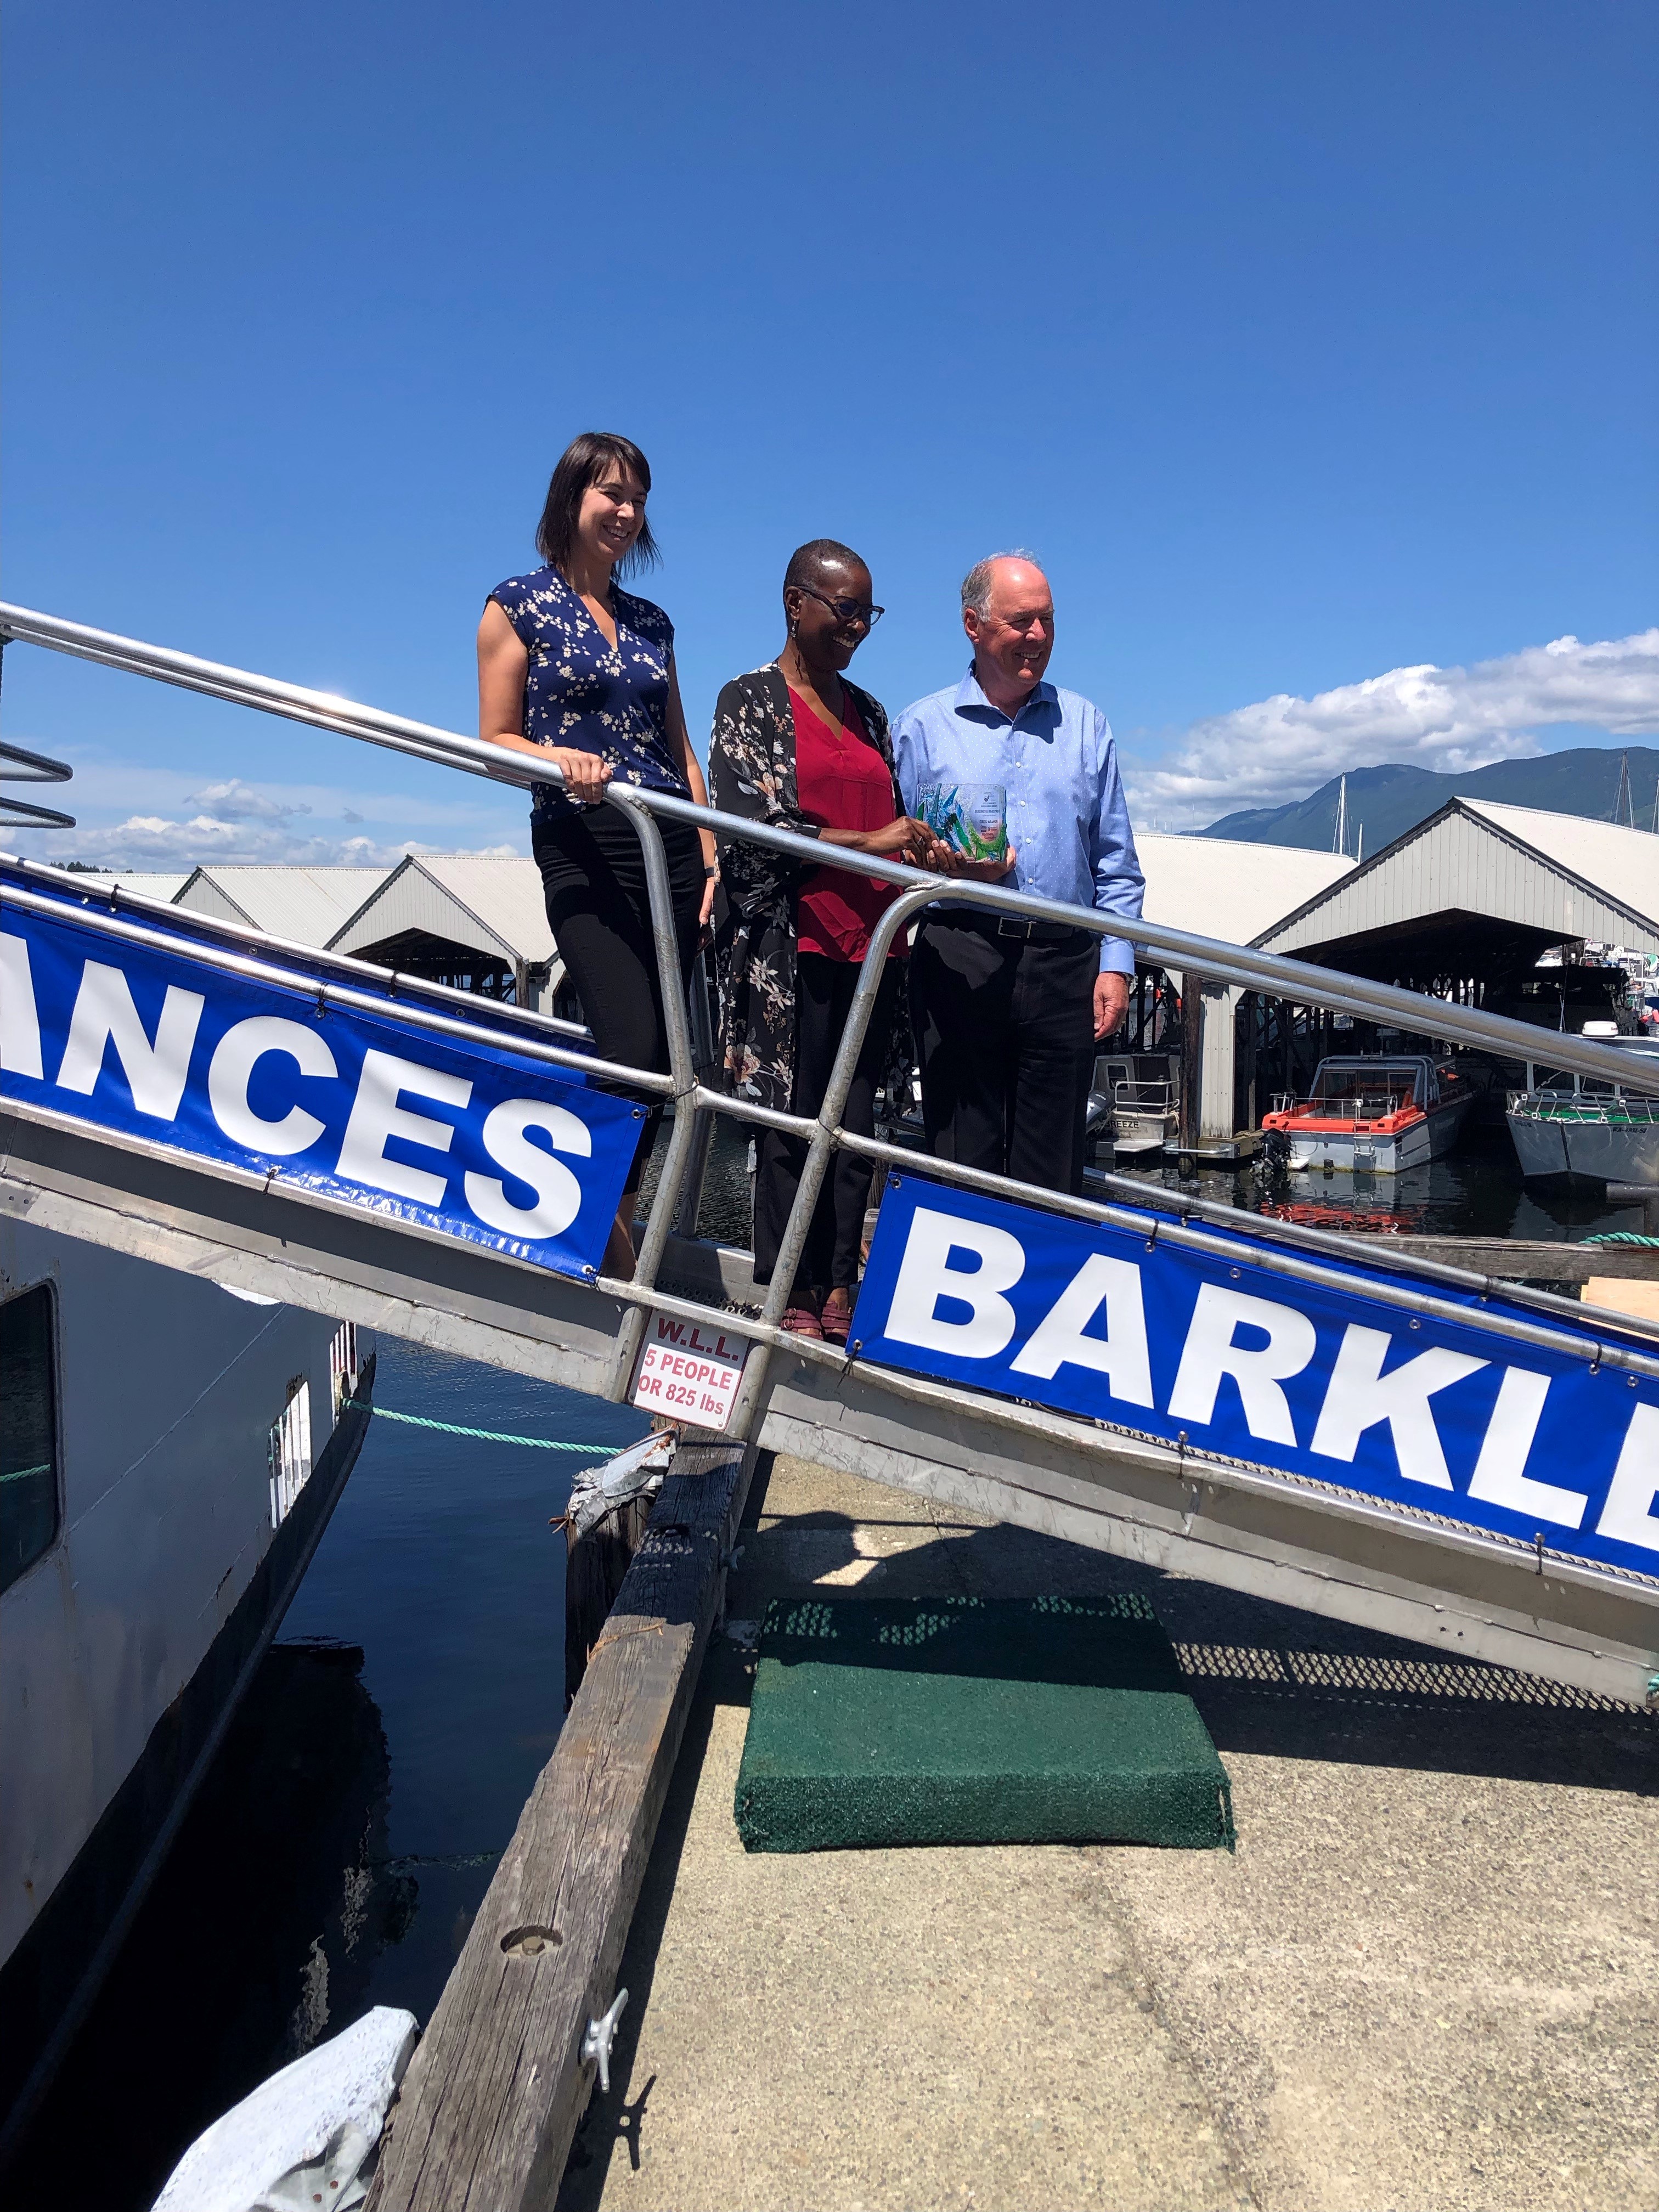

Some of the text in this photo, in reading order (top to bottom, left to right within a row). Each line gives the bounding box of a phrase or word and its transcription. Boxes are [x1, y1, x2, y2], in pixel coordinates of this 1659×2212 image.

[658, 1317, 738, 1361] W.L.L.
[644, 1348, 733, 1390] 5 PEOPLE
[638, 1375, 724, 1414] OR 825 lbs
